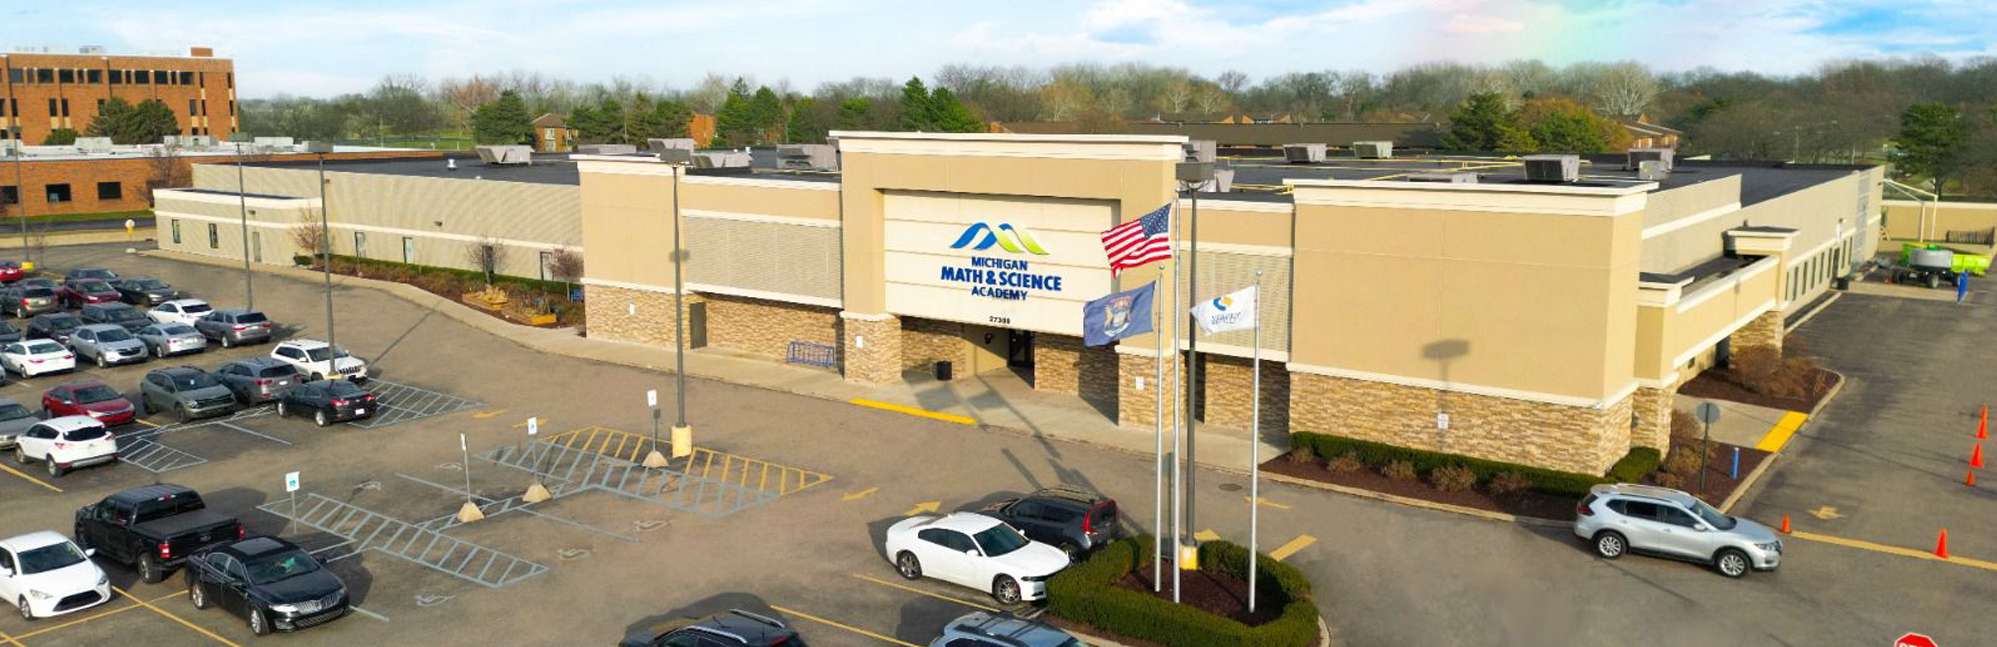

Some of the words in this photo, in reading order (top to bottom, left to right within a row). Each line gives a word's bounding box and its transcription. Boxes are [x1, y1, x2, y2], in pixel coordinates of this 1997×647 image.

[971, 256, 1028, 271] MICHIGAN
[941, 266, 983, 284] MATH
[985, 271, 997, 286] &
[998, 272, 1062, 291] SCIENCE
[971, 286, 1028, 301] ACADEMY
